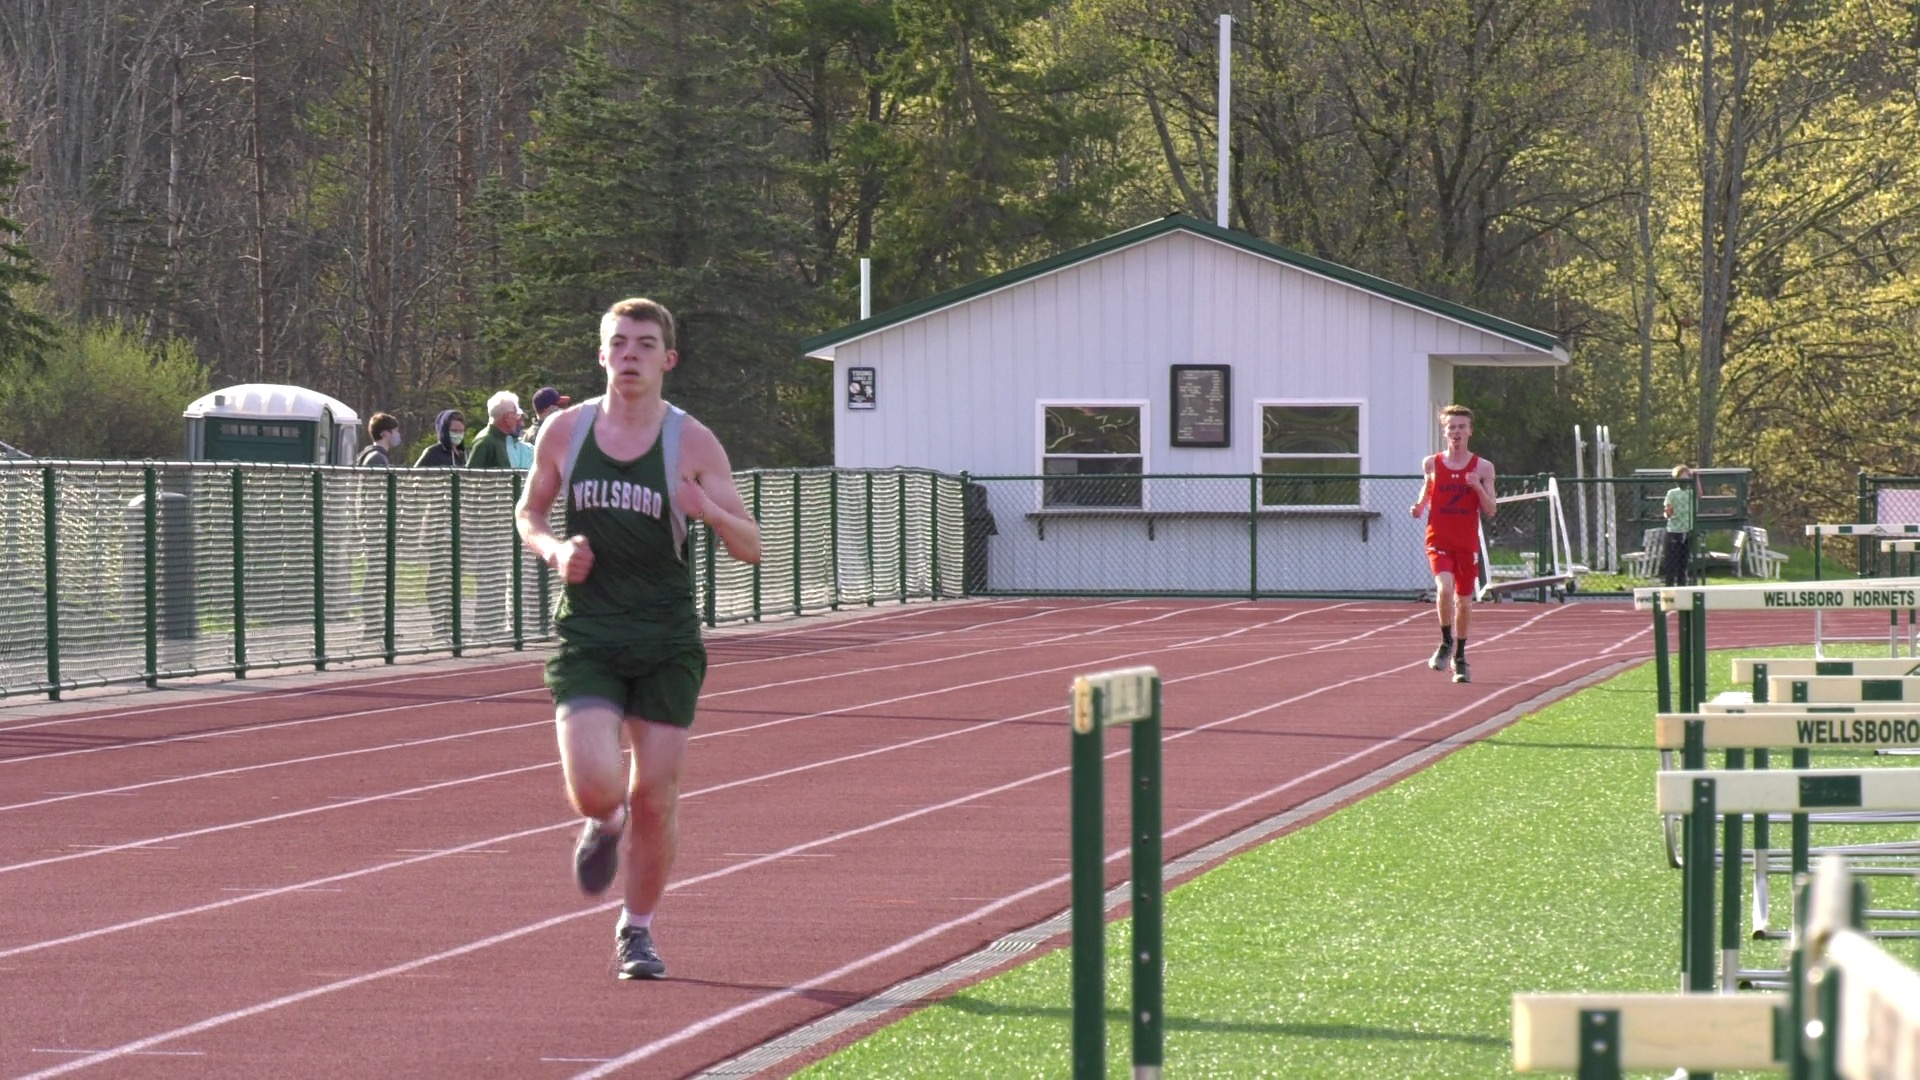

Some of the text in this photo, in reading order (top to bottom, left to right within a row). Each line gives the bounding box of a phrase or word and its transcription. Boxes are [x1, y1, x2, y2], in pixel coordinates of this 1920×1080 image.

[572, 478, 662, 520] WELLSBORO
[1764, 590, 1915, 607] WELLSBORO HORNETS
[1797, 719, 1920, 744] WELLSBORO
